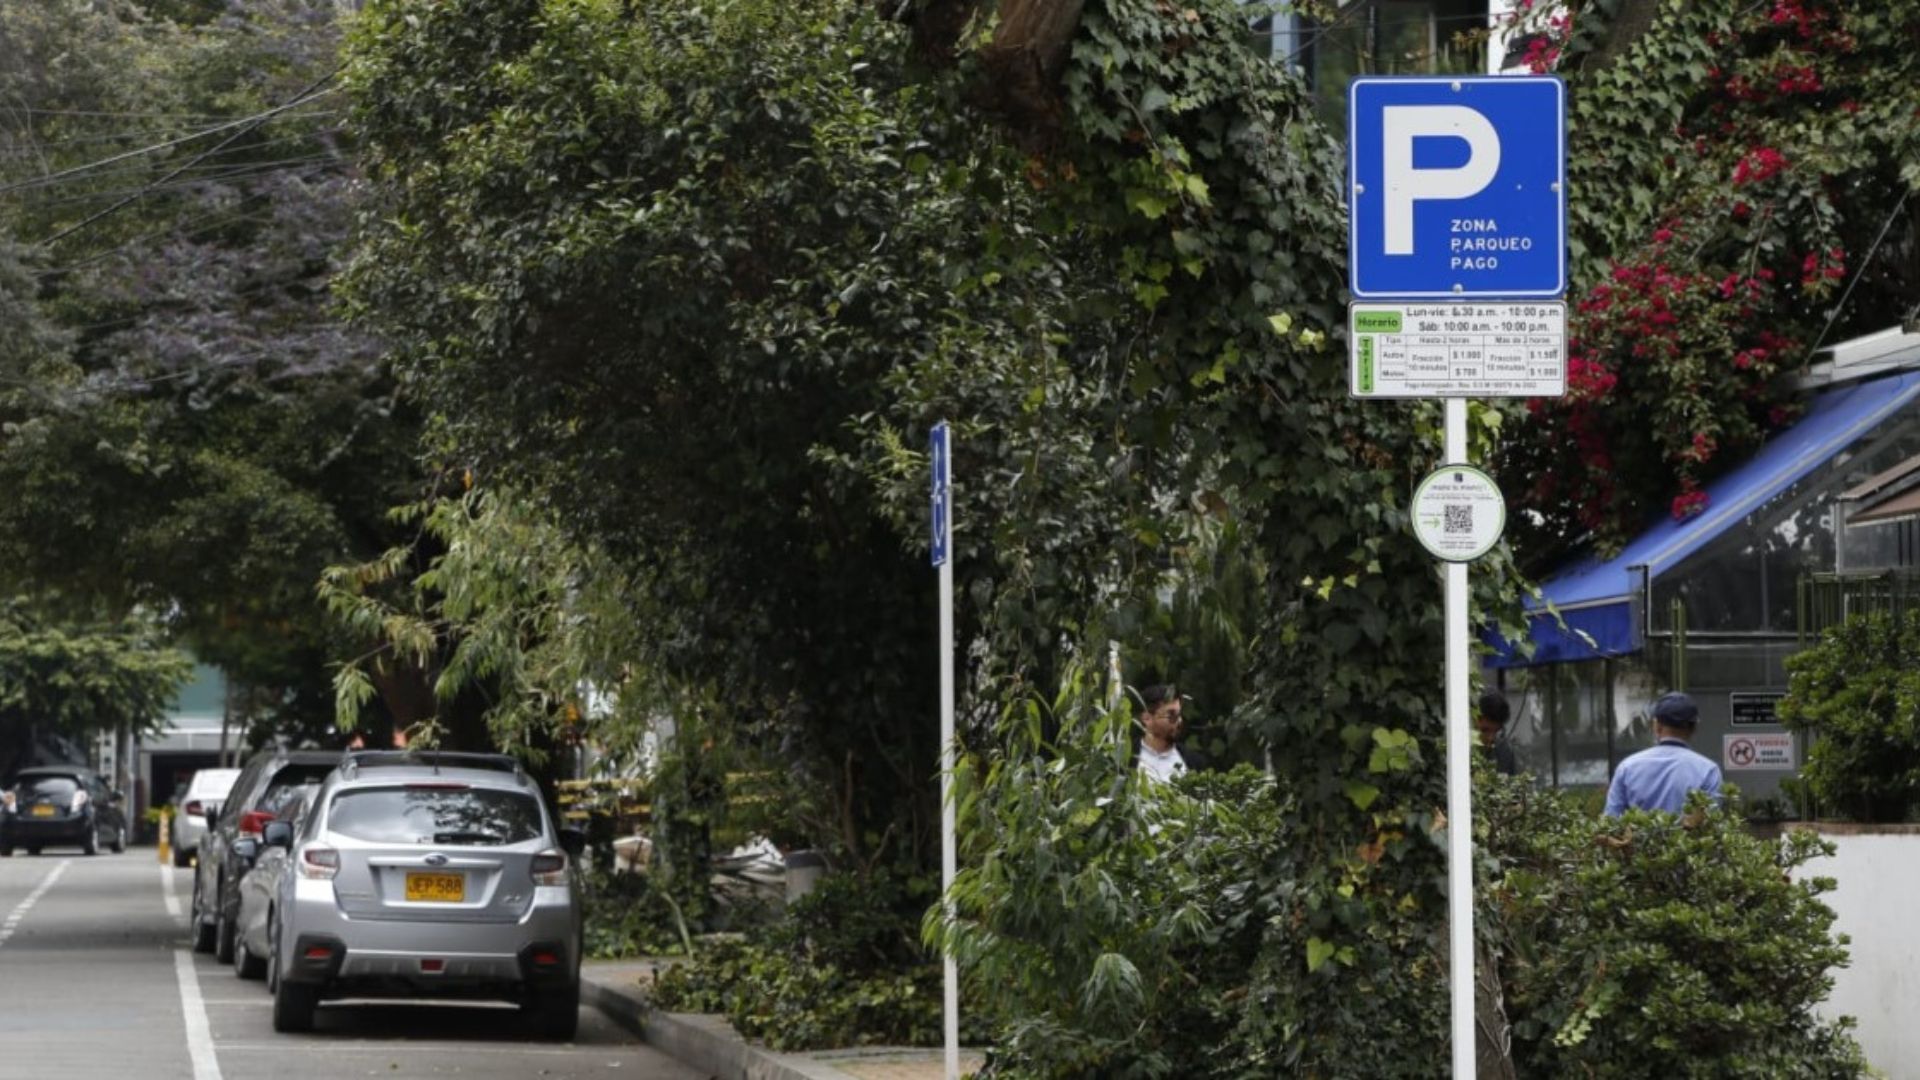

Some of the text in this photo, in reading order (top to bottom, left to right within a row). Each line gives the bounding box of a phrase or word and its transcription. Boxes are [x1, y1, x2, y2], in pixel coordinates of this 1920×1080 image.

[1383, 105, 1501, 255] P
[1451, 219, 1497, 232] ZONA
[1451, 237, 1532, 251] PARQUEO
[1451, 256, 1498, 269] PAGO
[1358, 317, 1398, 327] Horario
[1444, 321, 1470, 332] 10:00
[1501, 321, 1527, 332] 10:00
